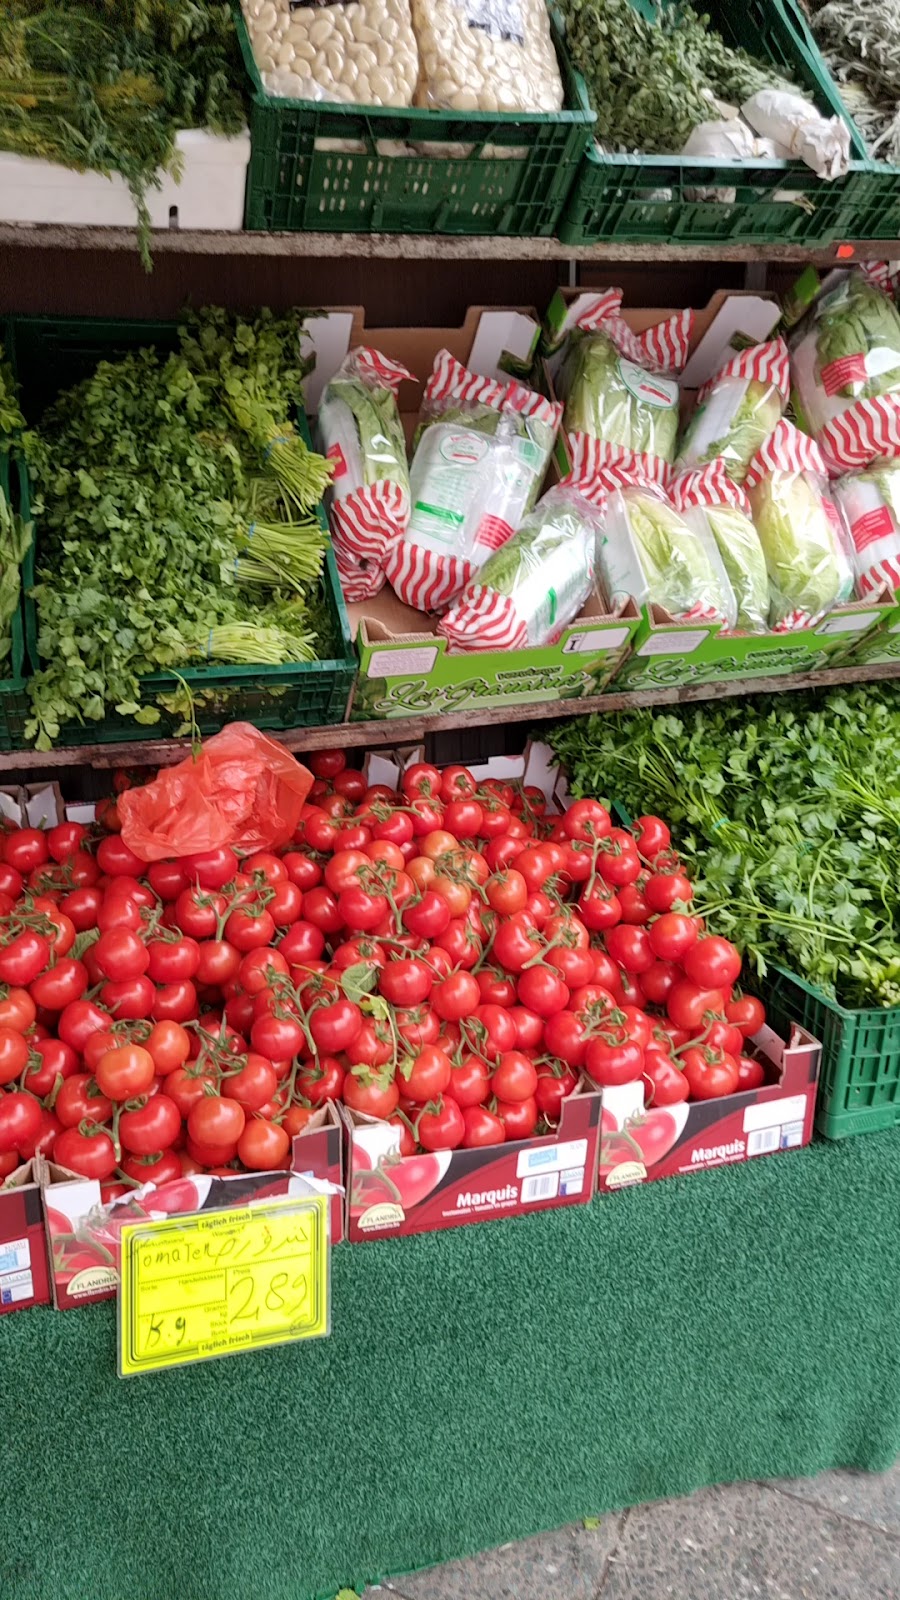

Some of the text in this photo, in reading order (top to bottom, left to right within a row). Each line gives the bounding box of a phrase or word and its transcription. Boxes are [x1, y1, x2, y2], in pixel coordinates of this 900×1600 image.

[690, 1138, 746, 1164] Marquis
[456, 1183, 519, 1209] Marquis
[201, 1211, 251, 1230] täglich frisch
[76, 1274, 118, 1291] FLANDRIA
[230, 1272, 308, 1325] 2,89
[201, 1333, 250, 1352] täglich frisch
